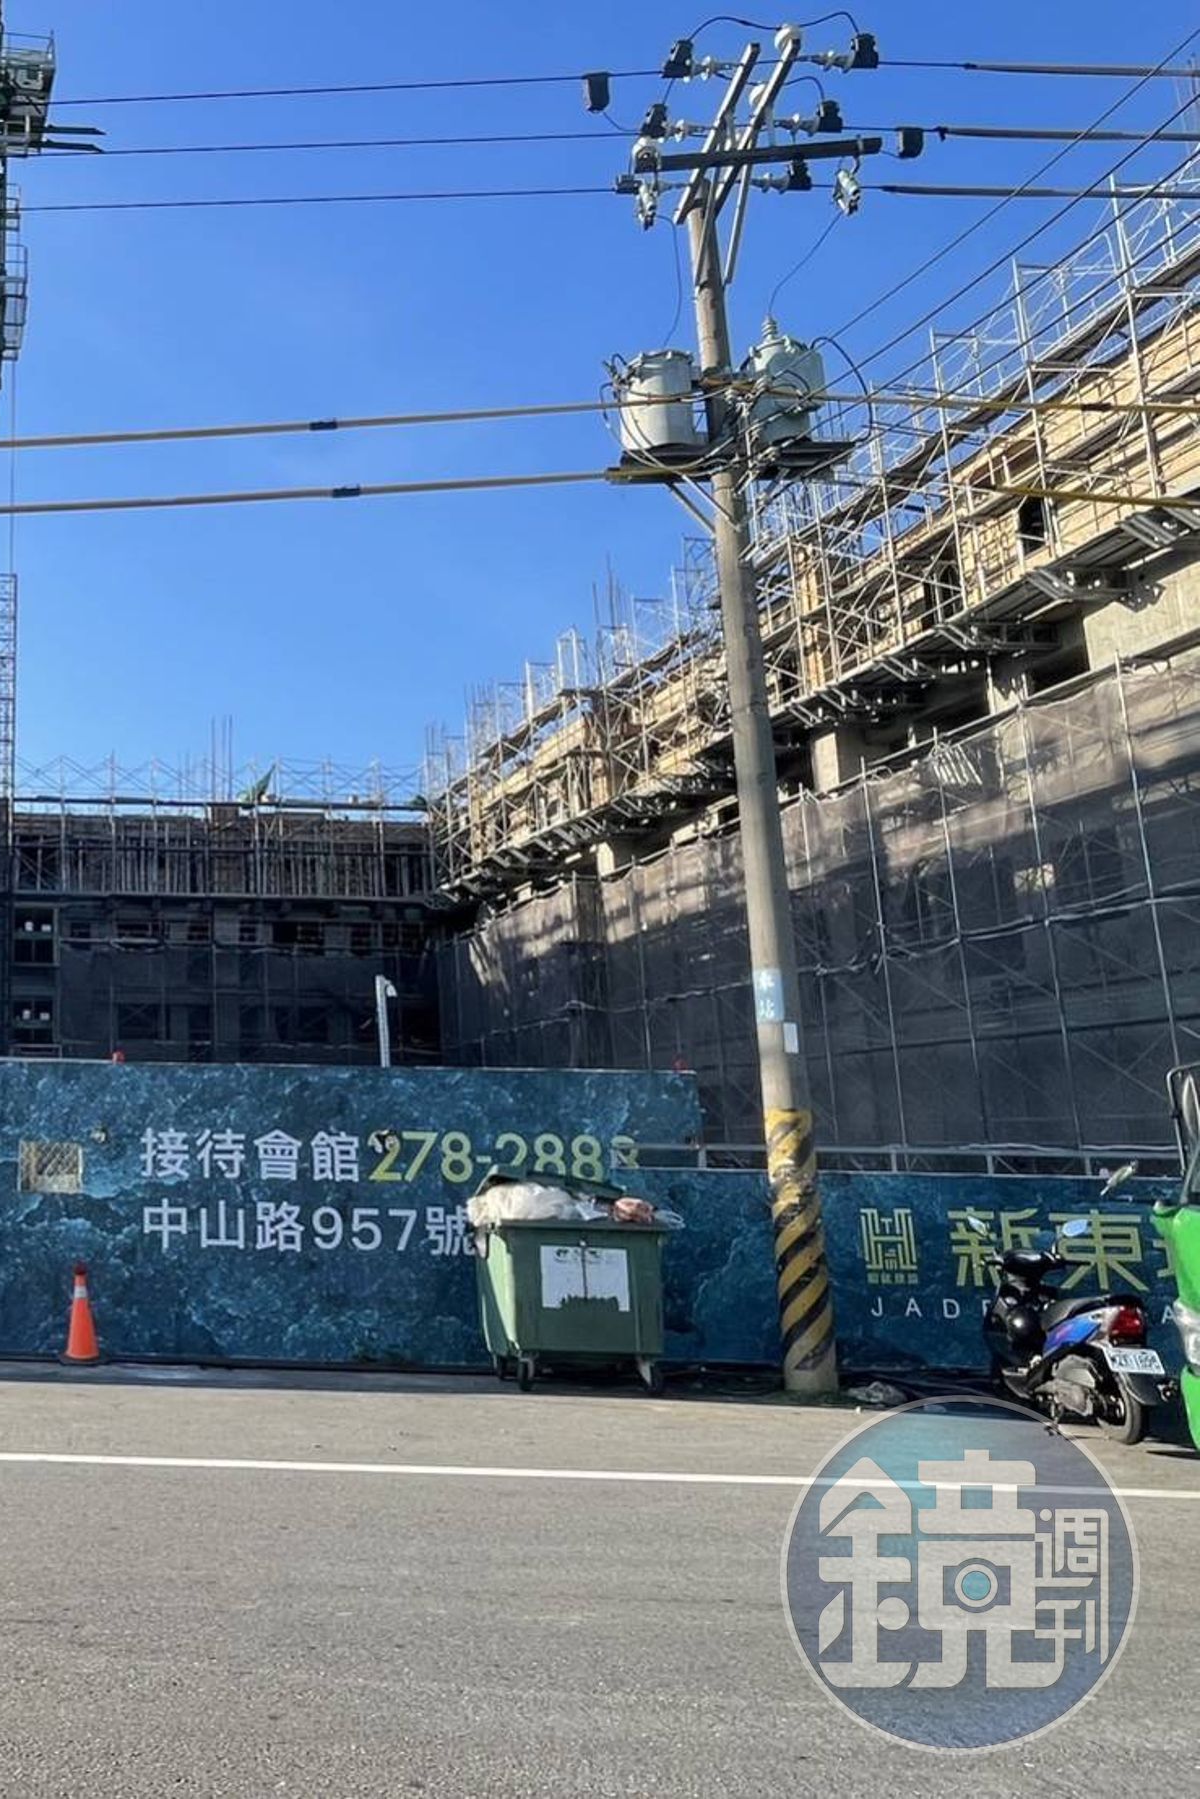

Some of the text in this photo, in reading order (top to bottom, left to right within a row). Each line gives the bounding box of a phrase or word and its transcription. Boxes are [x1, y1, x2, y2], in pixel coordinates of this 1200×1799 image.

[143, 1198, 475, 1256] 中山路957號
[948, 1207, 1176, 1291] 新東
